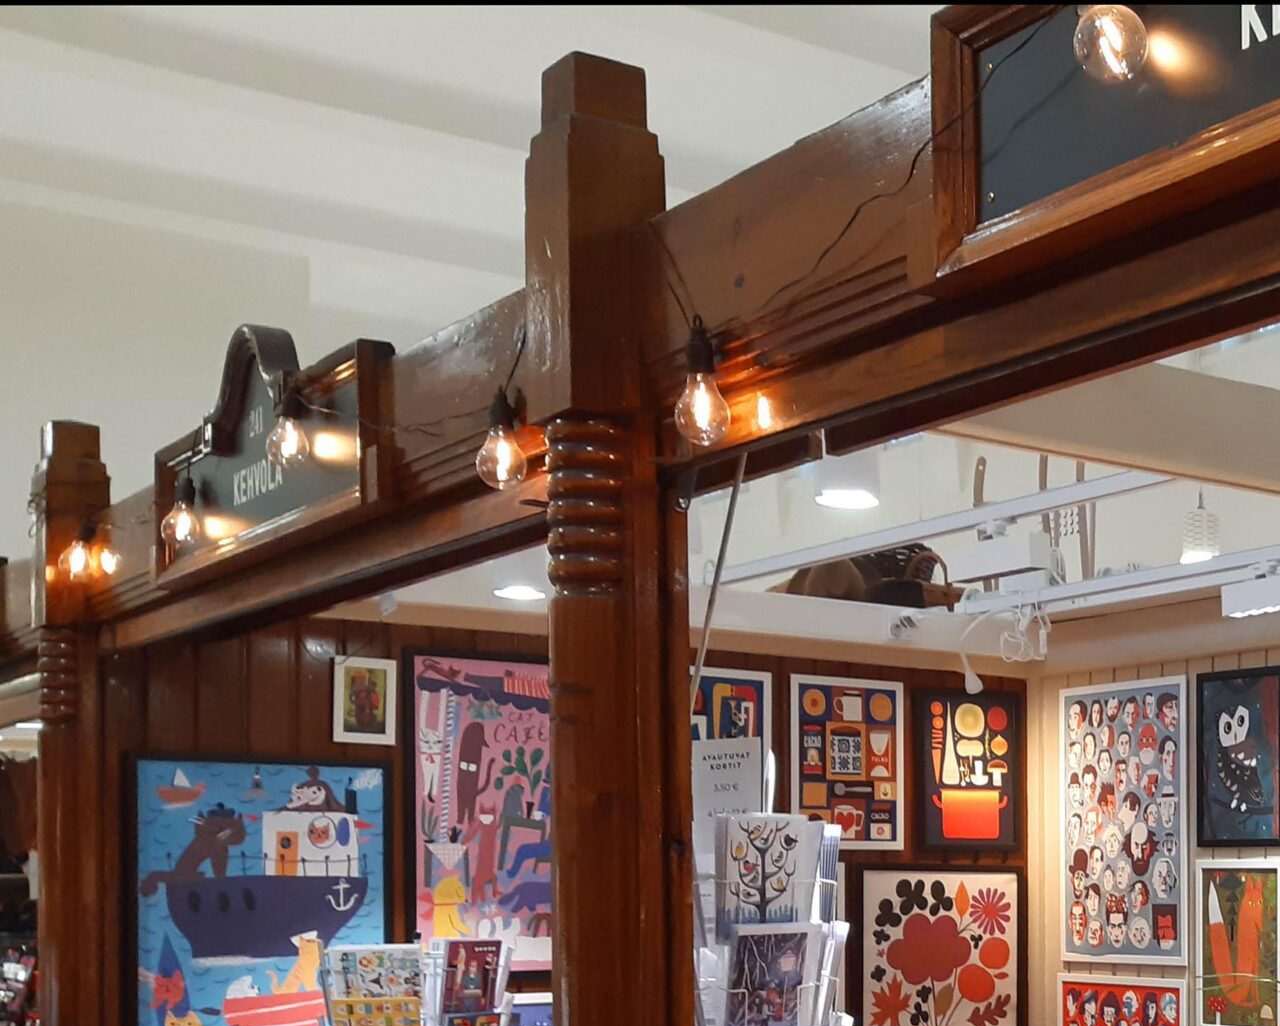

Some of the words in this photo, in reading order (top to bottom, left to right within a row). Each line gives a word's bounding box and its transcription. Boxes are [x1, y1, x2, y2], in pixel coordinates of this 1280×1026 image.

[233, 459, 283, 507] KEHVOLA
[702, 751, 750, 761] AVAUTUVAT
[710, 762, 742, 771] KORTIT
